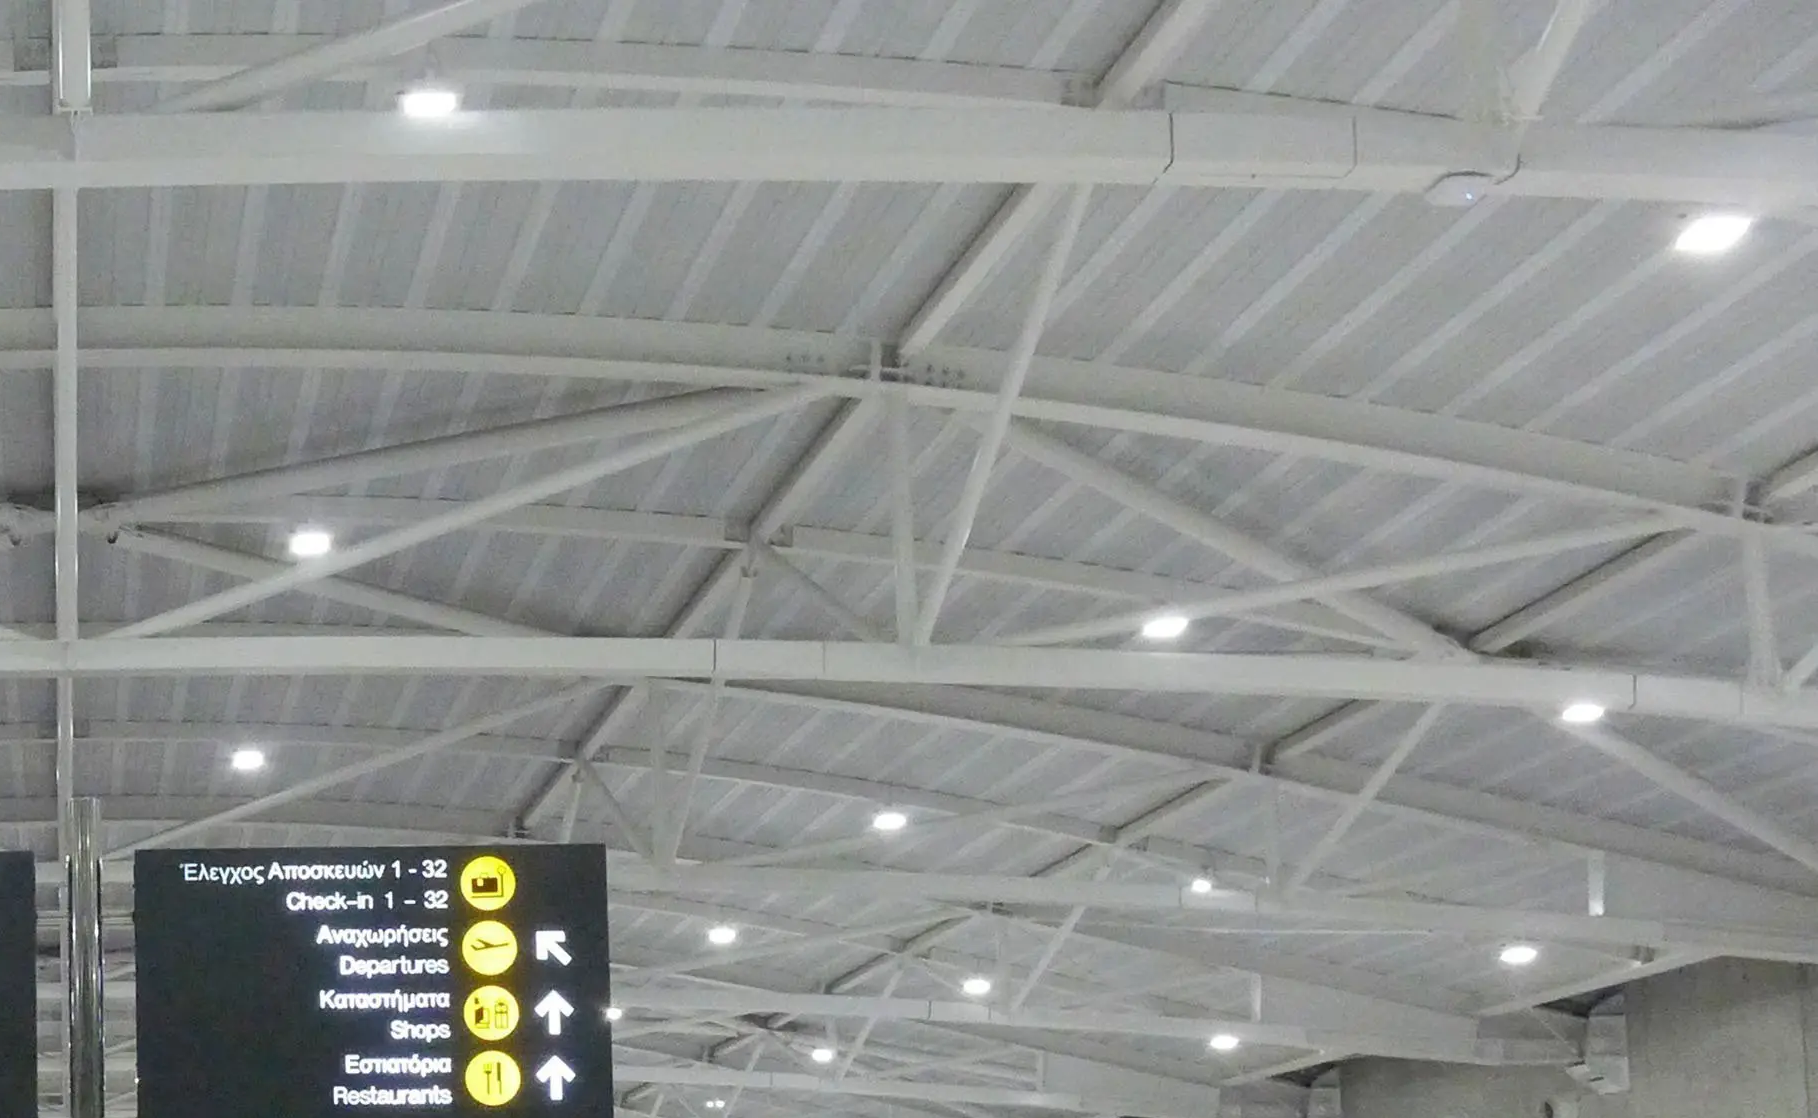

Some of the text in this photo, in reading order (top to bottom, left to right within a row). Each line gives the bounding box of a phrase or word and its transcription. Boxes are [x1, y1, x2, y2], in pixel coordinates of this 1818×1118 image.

[178, 862, 265, 885] Έλεγχος
[267, 859, 386, 881] Αποσκευών
[390, 859, 402, 879] 1
[421, 858, 448, 879] 32
[285, 891, 374, 912] Check-in
[383, 890, 395, 910] 1
[423, 889, 450, 910] 32
[315, 924, 449, 949] Αναχωρήσεις
[338, 954, 451, 980] Departures
[318, 988, 451, 1013] Καταστήματα
[389, 1019, 452, 1044] Shops
[344, 1053, 453, 1079] Εστιατόρια
[332, 1084, 454, 1106] Restaurants
